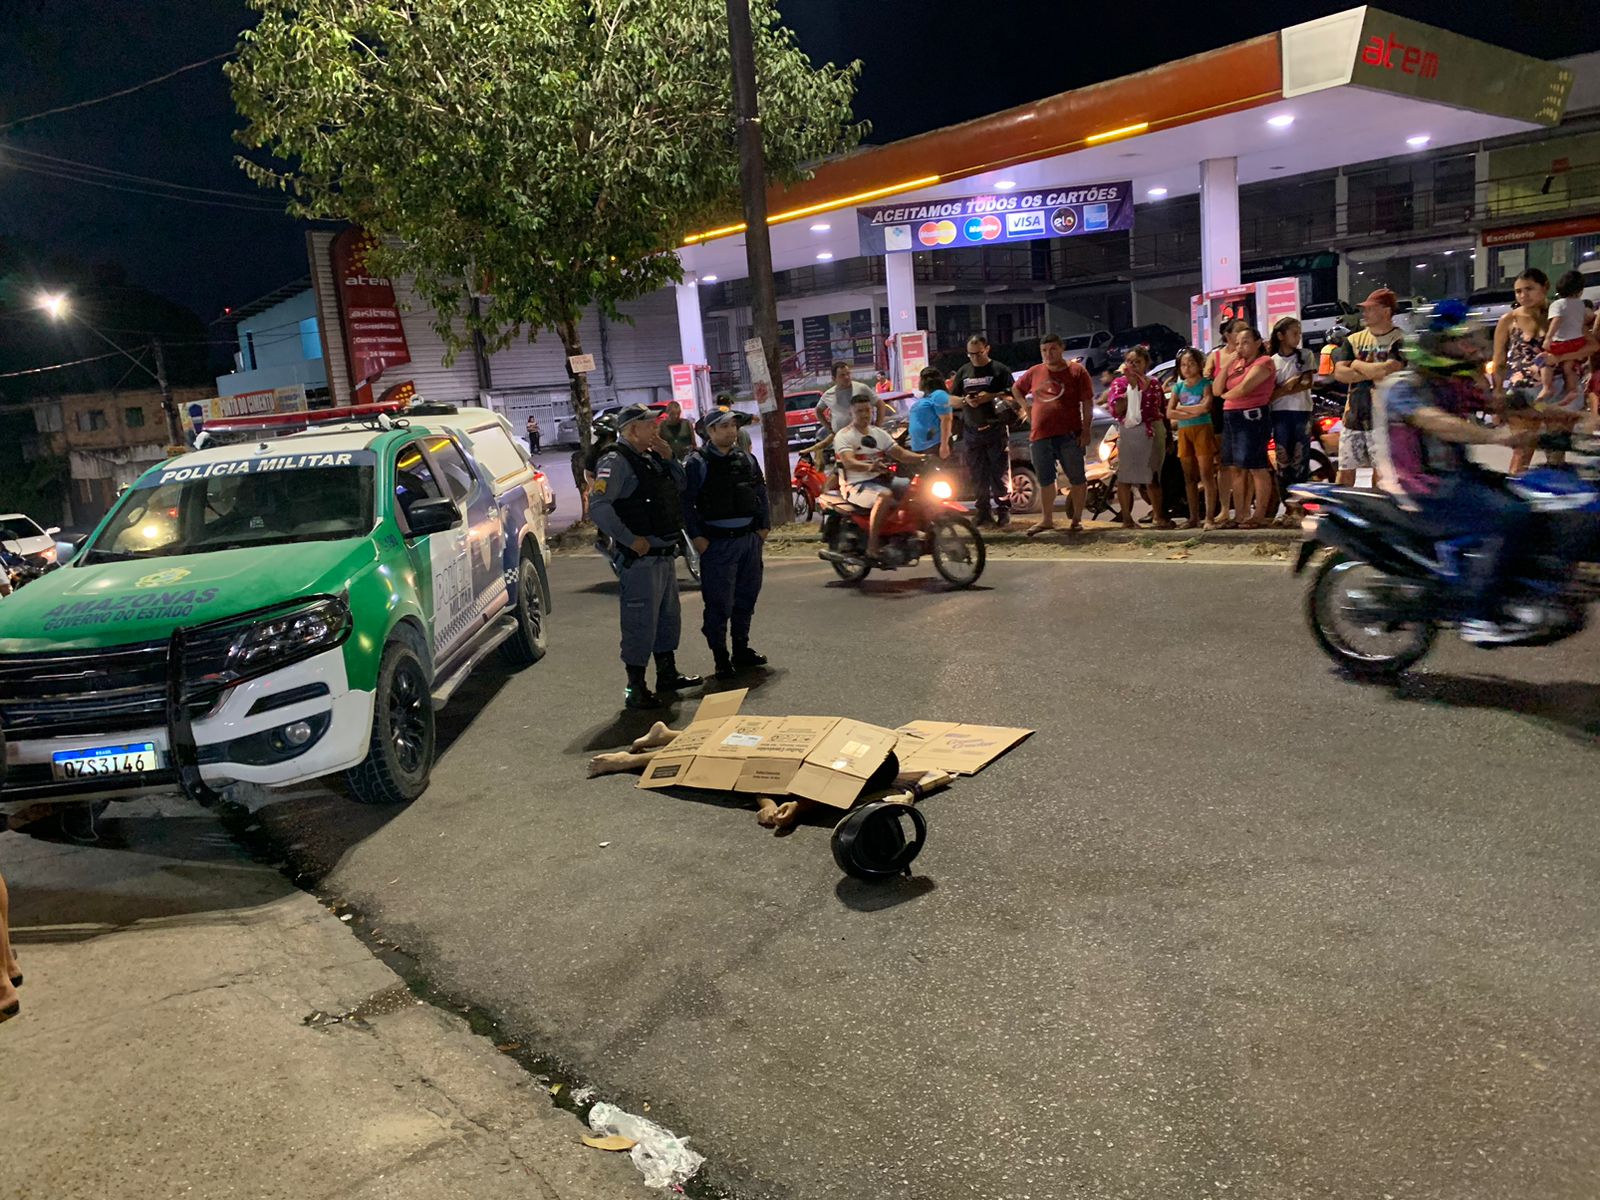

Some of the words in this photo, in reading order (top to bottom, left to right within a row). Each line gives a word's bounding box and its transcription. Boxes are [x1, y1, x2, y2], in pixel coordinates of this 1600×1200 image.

[1361, 31, 1440, 80] atem
[873, 204, 963, 224] ACEITAMOS
[966, 196, 1017, 214] TODOS
[1021, 194, 1043, 208] OS
[1046, 186, 1118, 205] CARTÕES
[1013, 213, 1041, 228] VISA
[1054, 214, 1074, 227] elo
[345, 274, 390, 287] atem
[159, 462, 250, 484] POLÍCIA
[256, 453, 353, 472] MILITAR
[43, 611, 112, 631] GOVERNO
[113, 608, 135, 621] DO
[137, 604, 194, 620] ESTADO
[44, 588, 219, 618] AMAZONAS
